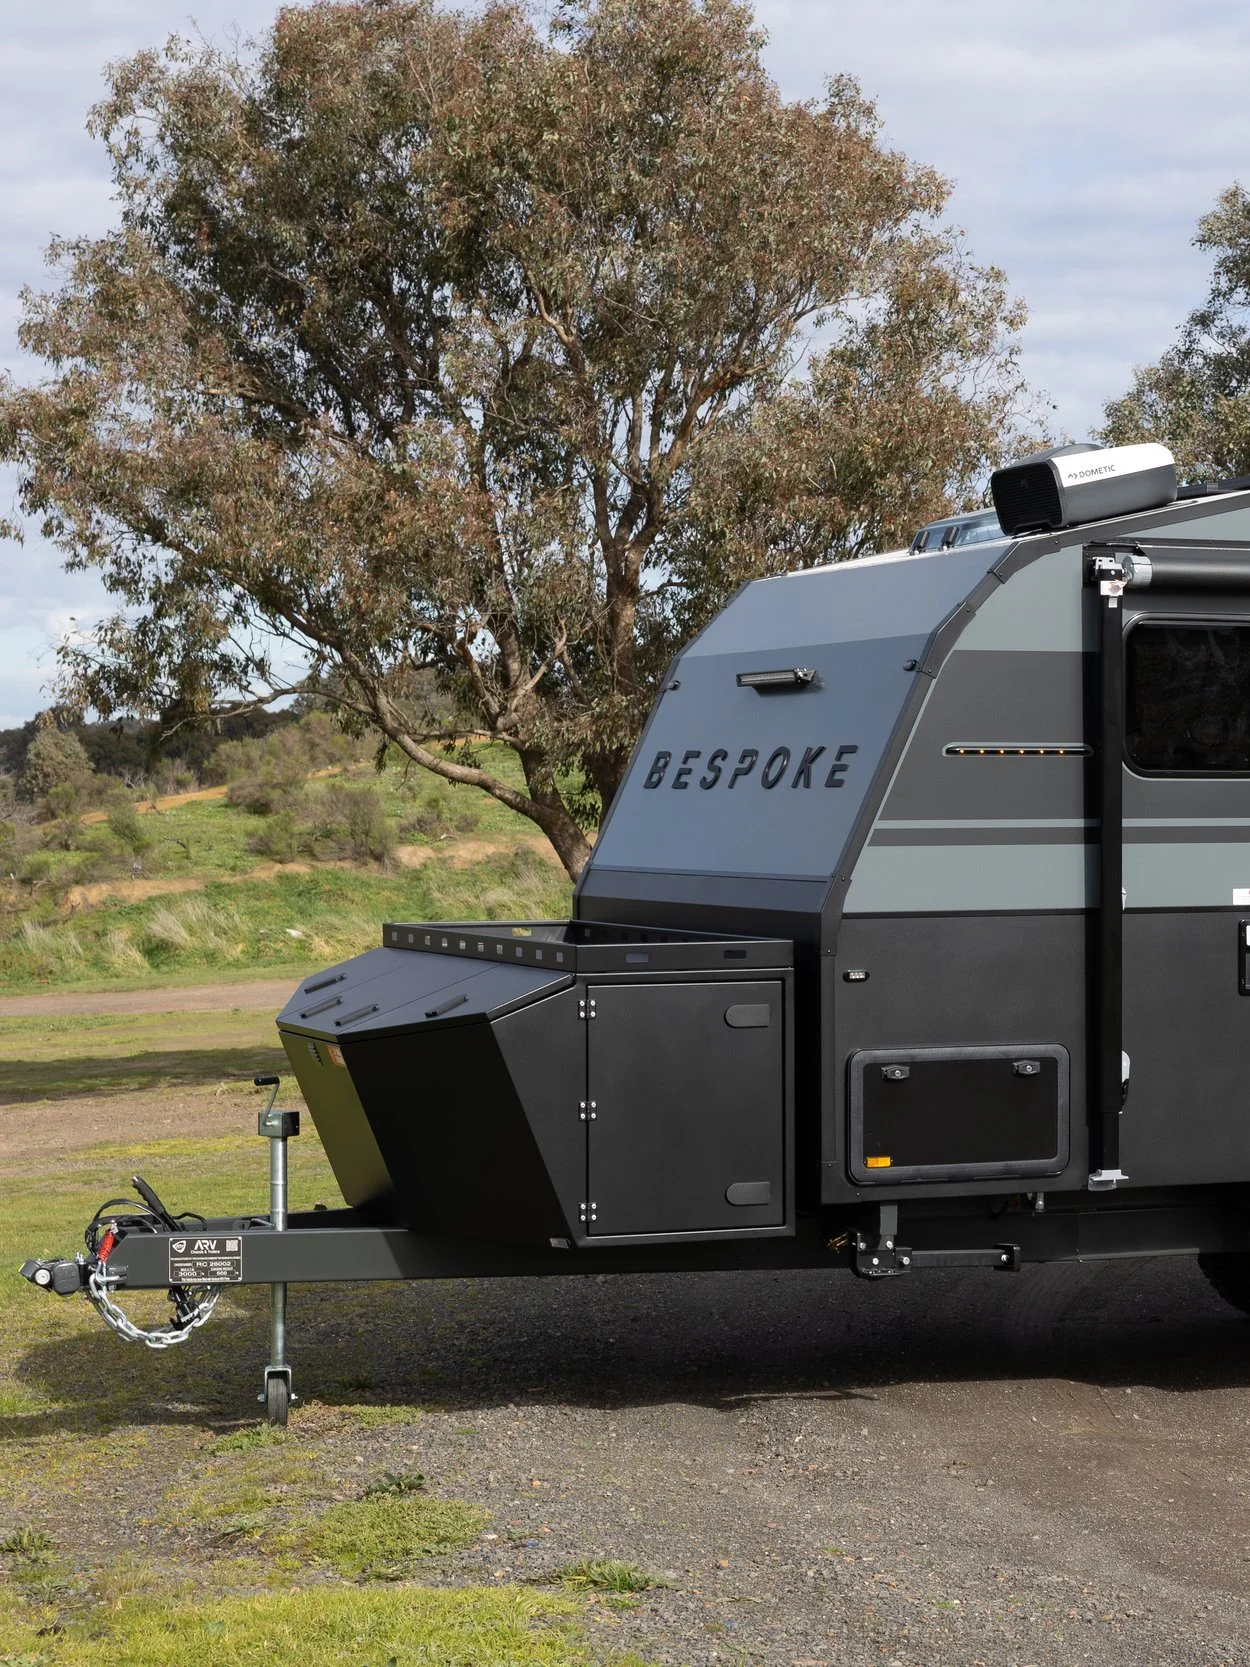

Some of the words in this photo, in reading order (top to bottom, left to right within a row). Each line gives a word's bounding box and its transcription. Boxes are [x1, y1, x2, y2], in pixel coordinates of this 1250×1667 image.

[1079, 464, 1116, 479] DOMETIC
[643, 744, 859, 790] BESPOKE
[194, 1240, 217, 1250] ARV
